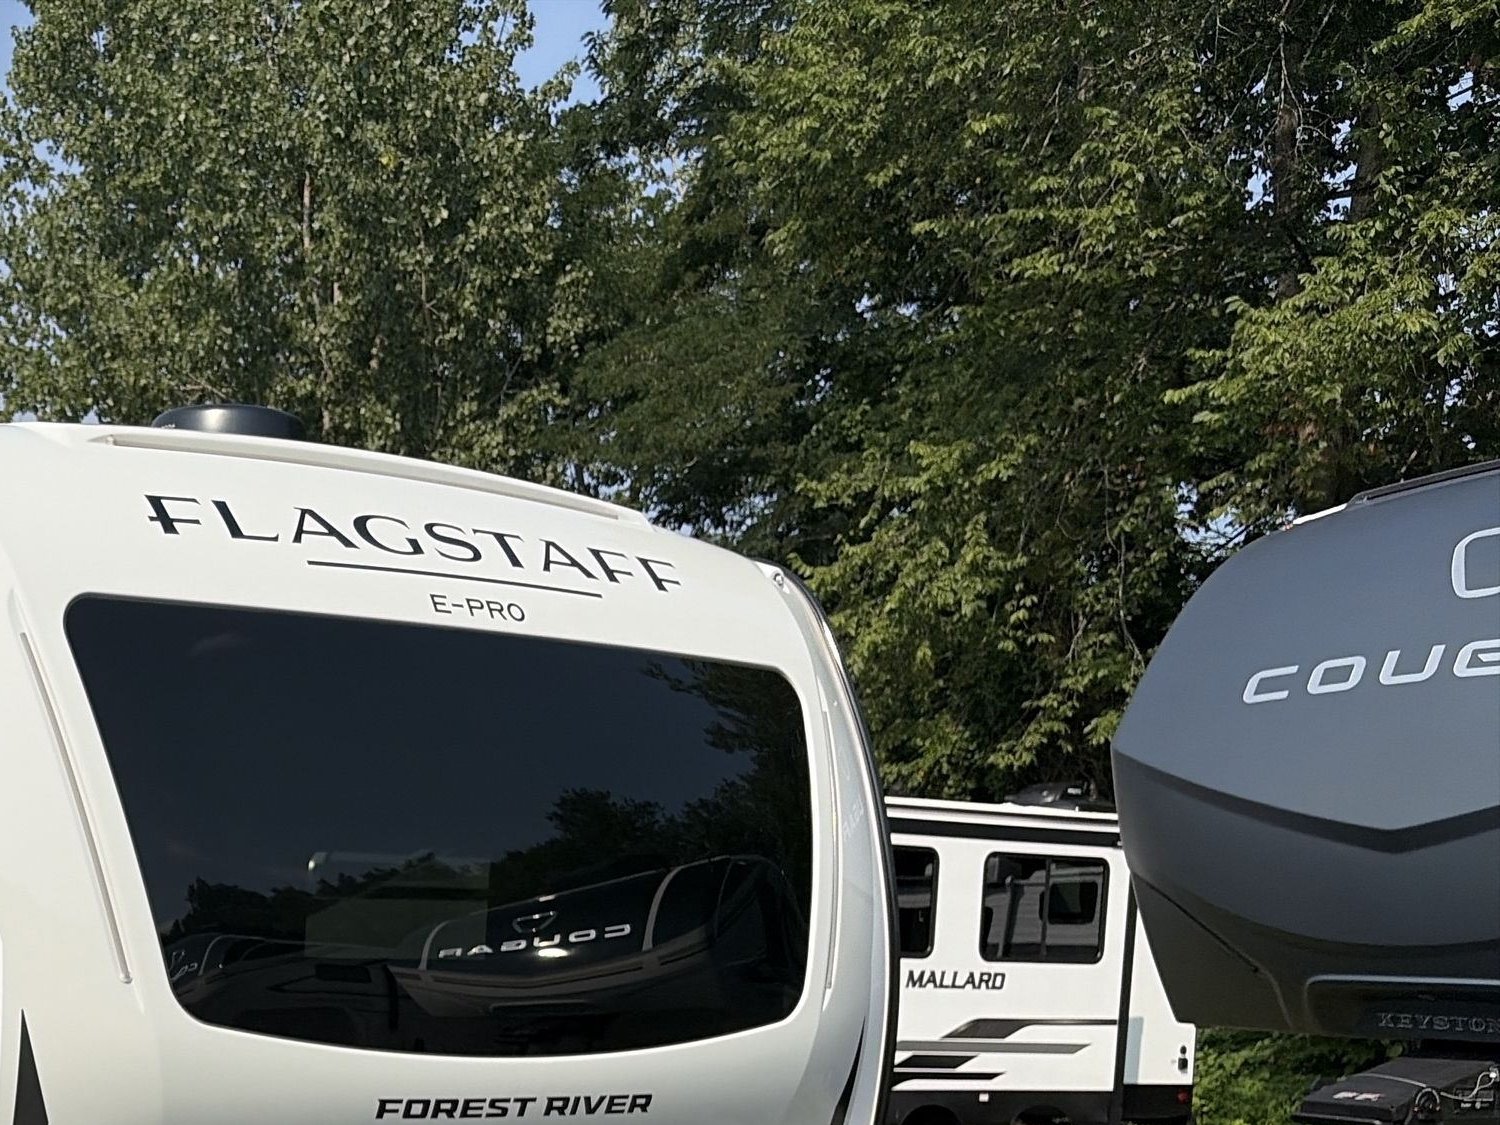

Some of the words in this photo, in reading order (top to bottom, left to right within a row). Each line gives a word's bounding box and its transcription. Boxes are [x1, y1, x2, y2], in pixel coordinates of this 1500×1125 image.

[144, 494, 681, 592] FLAGSTAFF
[430, 593, 526, 623] E-PRO
[1243, 638, 1500, 704] COUG
[905, 970, 1006, 990] MALLARD
[375, 1098, 537, 1120] FOREST
[543, 1094, 653, 1117] RIVER
